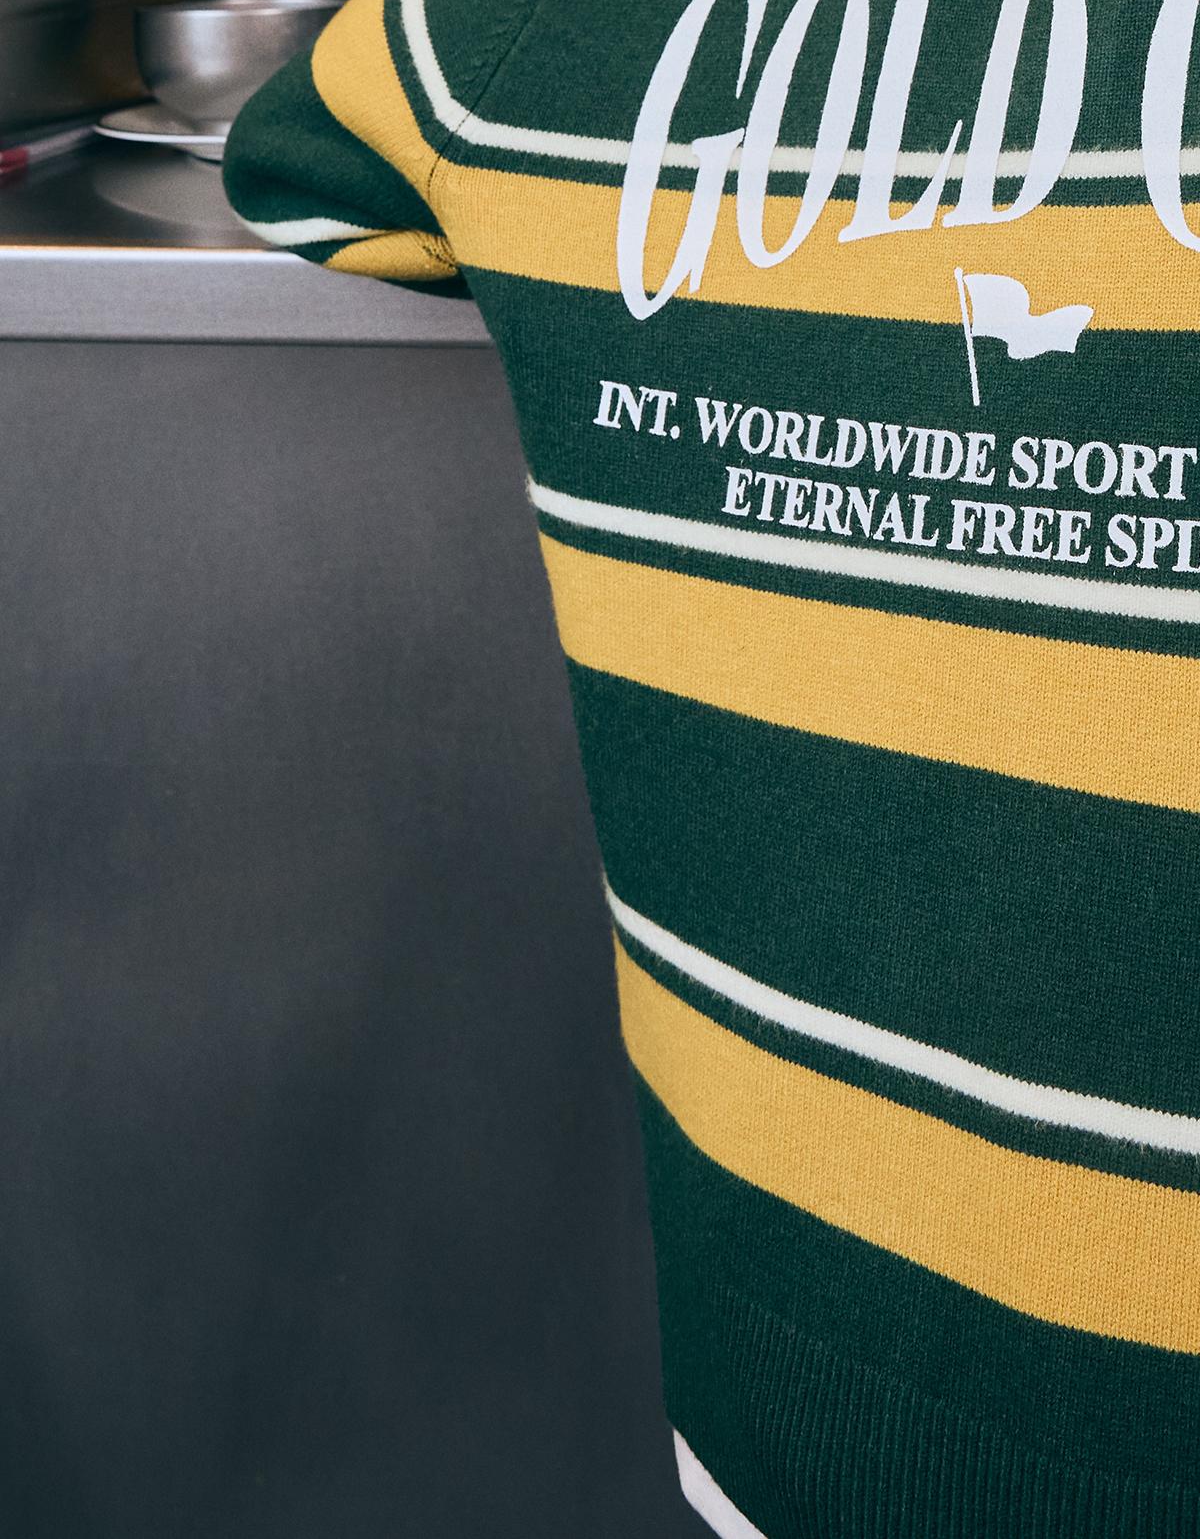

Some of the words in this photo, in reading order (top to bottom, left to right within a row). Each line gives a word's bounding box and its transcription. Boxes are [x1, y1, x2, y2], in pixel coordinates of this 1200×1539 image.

[592, 380, 680, 439] INT.
[694, 396, 997, 487] WORLDWIDE
[1008, 437, 1199, 502] SPORT
[721, 466, 942, 548] ETERNAL
[946, 499, 1093, 565] FREE
